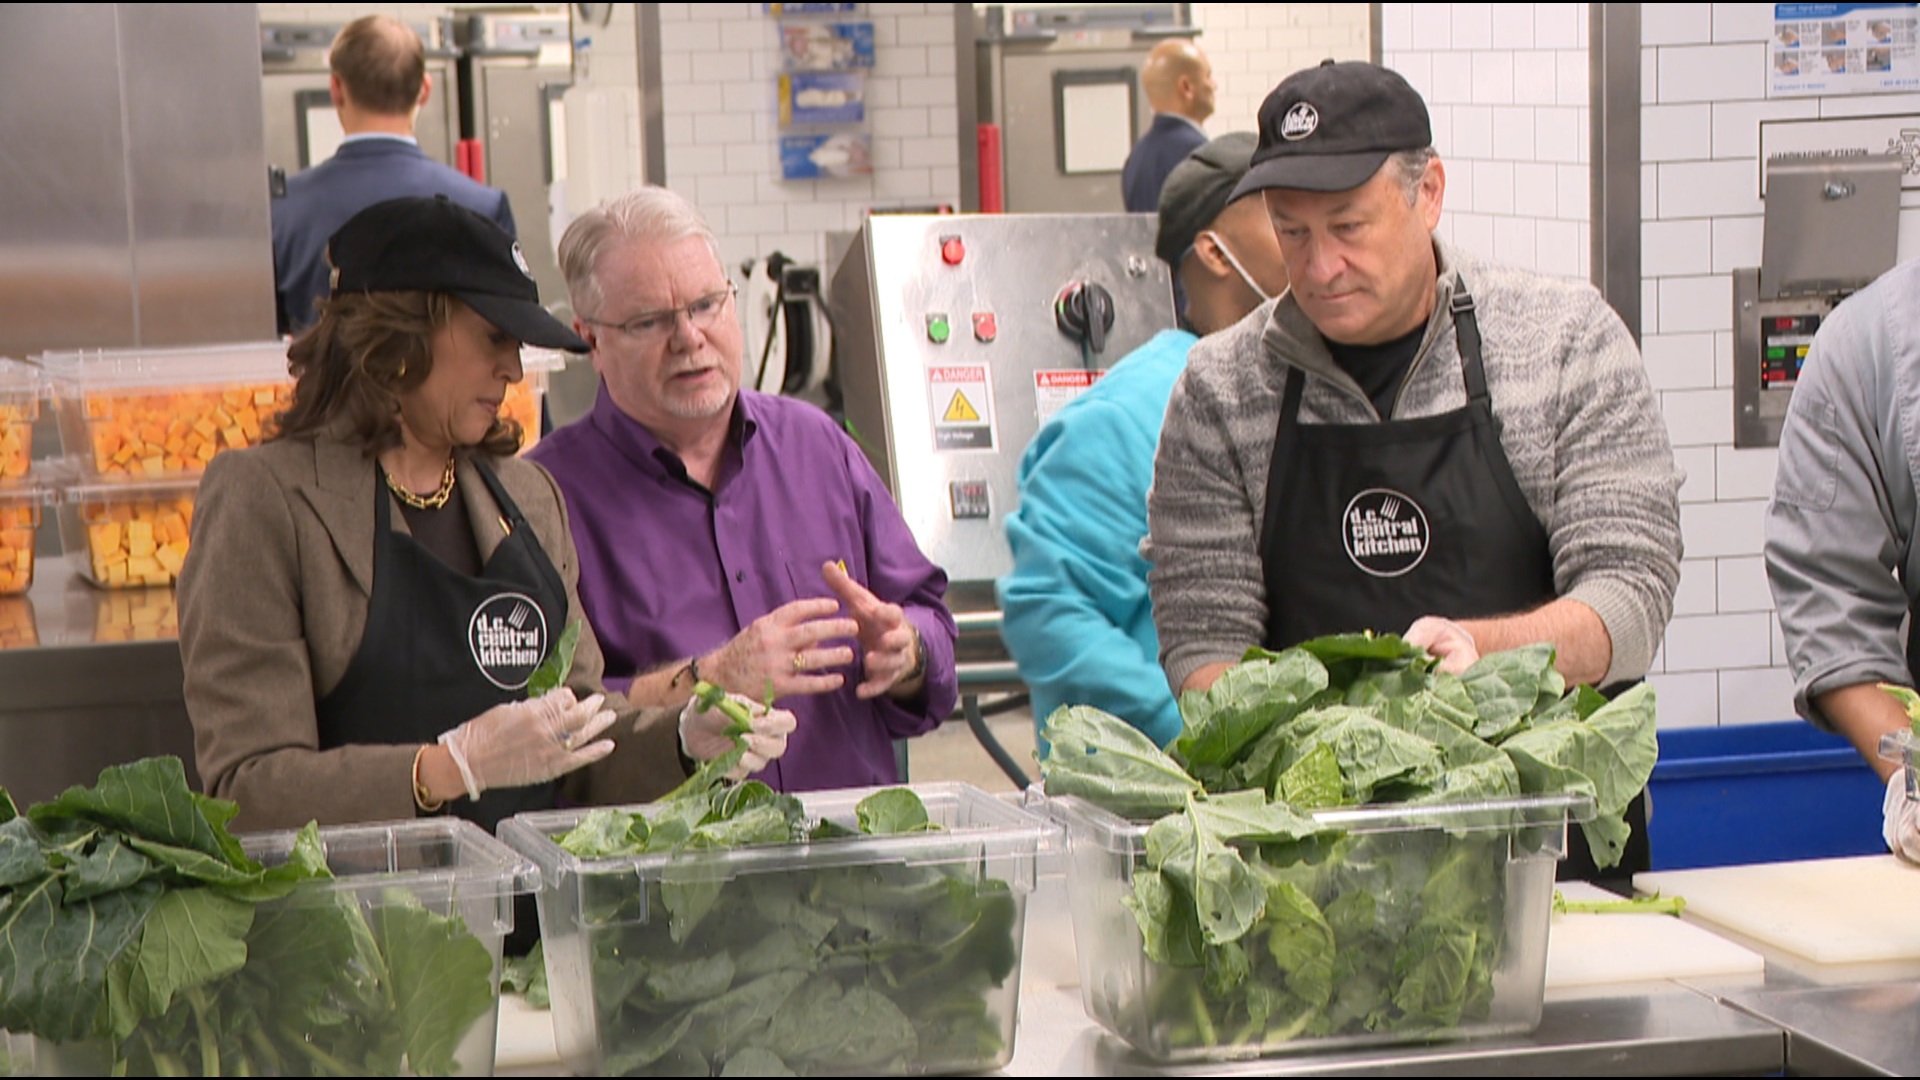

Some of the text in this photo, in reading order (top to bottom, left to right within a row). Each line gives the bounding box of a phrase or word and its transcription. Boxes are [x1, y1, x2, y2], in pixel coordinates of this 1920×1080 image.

[944, 367, 984, 381] DANGER
[1051, 374, 1088, 383] DANGER
[1350, 507, 1382, 524] d.c.
[1352, 516, 1418, 538] central
[1354, 534, 1421, 556] kitchen
[477, 613, 508, 632] d.c.
[478, 627, 538, 647] central
[480, 646, 538, 666] kitchen
